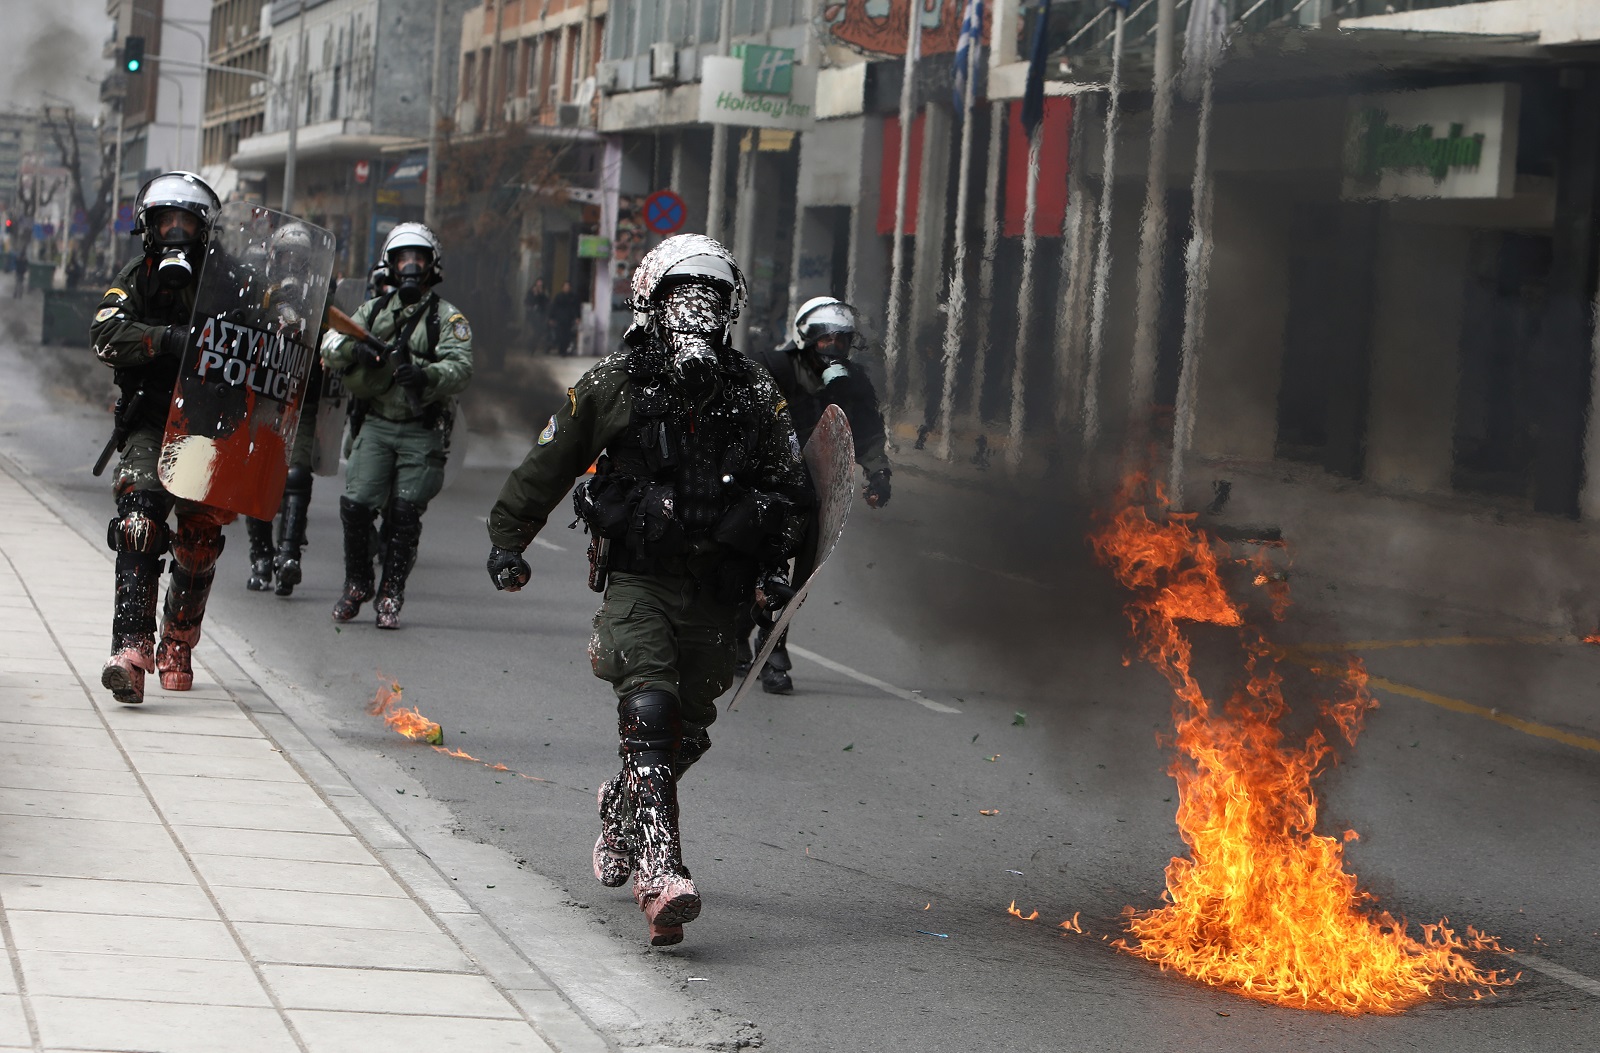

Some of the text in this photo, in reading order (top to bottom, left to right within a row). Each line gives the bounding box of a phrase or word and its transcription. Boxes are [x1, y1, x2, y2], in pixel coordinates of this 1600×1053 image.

[716, 91, 810, 118] Holiday Inn
[196, 317, 309, 378] ΑΣΤΥΝΟΜΙΑ
[198, 350, 300, 403] POLICE
